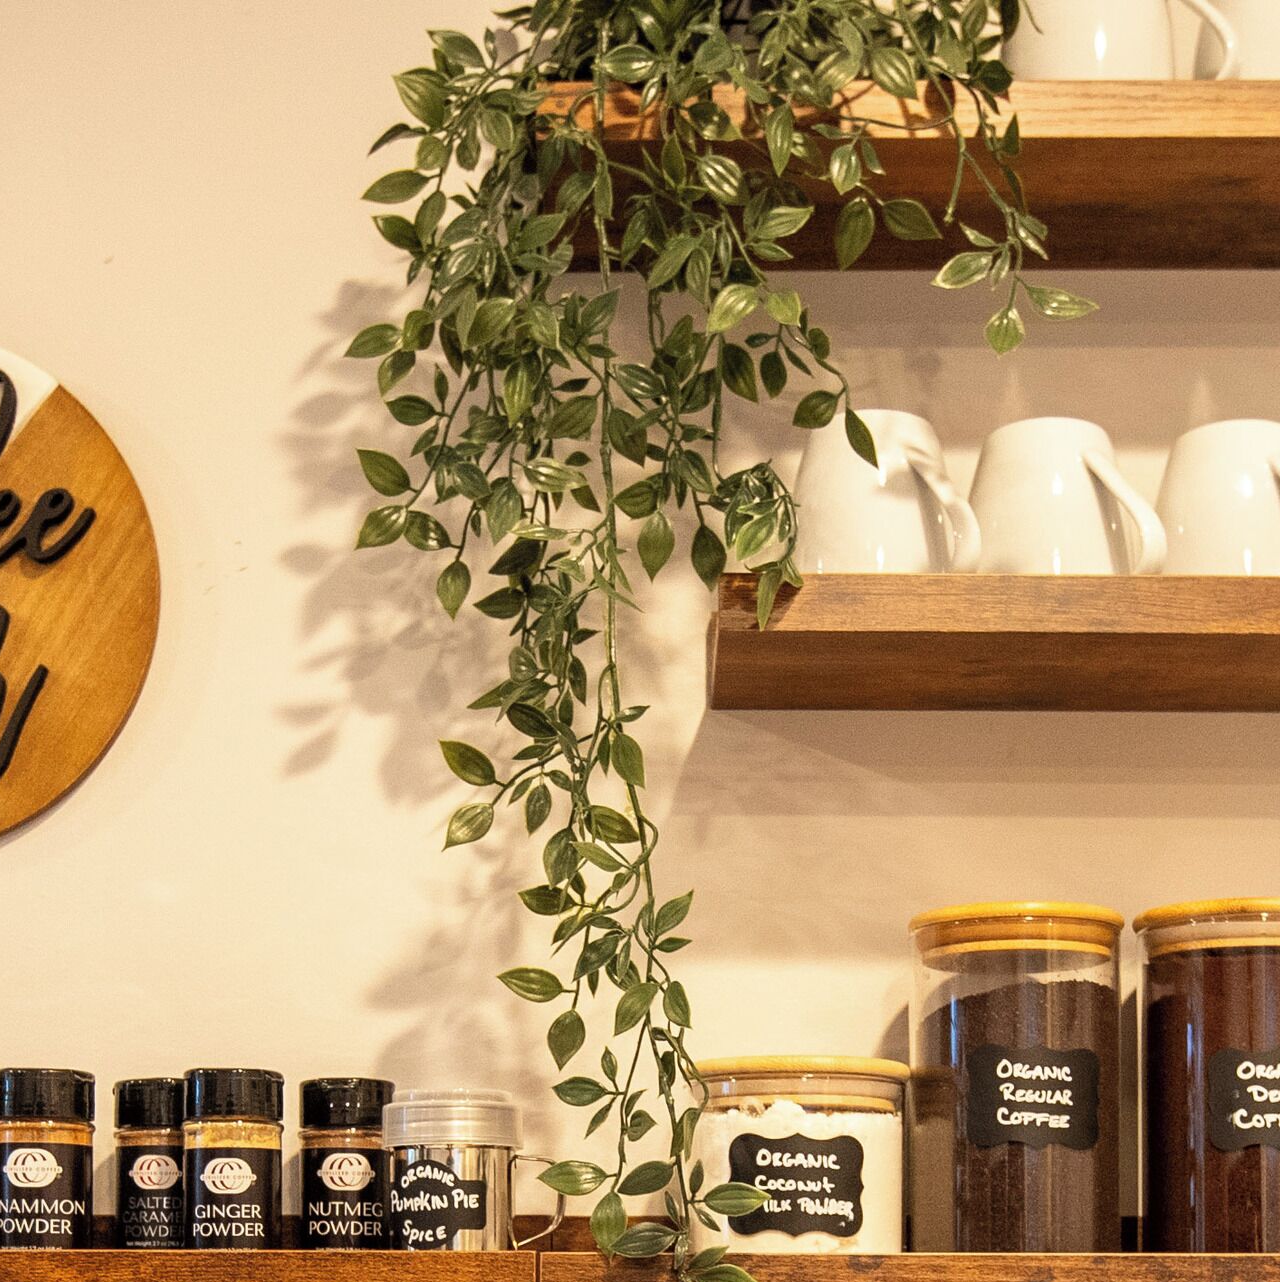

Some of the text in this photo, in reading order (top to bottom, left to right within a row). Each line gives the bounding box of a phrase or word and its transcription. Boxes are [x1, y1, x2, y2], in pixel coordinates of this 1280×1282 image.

[996, 1058, 1073, 1082] ORGANIC
[999, 1082, 1074, 1106] REGULAR
[996, 1106, 1071, 1128] COFFEE
[756, 1148, 840, 1169] ORGANIC
[401, 1164, 456, 1189] ORGANIC
[129, 1196, 183, 1210] SALTED
[308, 1201, 384, 1217] NUTMEG
[390, 1188, 480, 1213] PUMPKIN PIE
[122, 1210, 185, 1224] CARAME
[194, 1203, 262, 1219] GINGER
[193, 1222, 265, 1238] POWDER
[309, 1220, 383, 1236] POWDER
